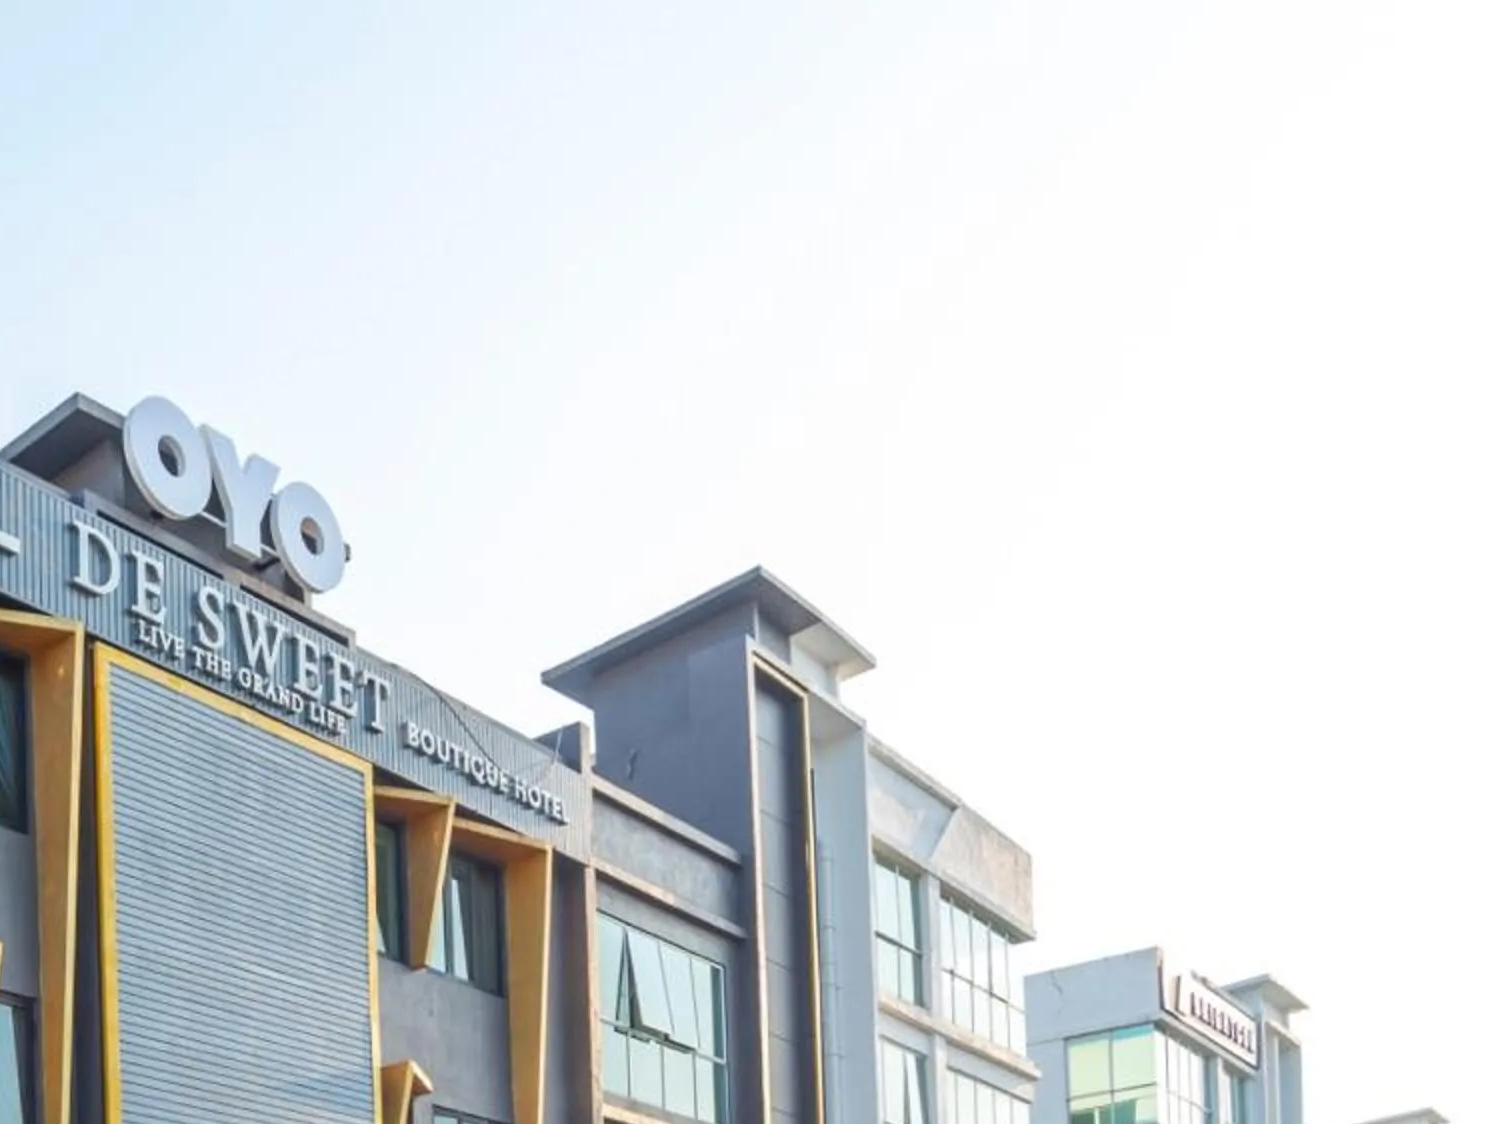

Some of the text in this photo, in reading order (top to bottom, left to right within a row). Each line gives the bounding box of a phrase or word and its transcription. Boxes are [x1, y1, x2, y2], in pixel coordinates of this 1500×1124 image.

[123, 396, 347, 595] OYO
[70, 519, 168, 624] DE
[197, 583, 392, 734] SWEET
[137, 619, 349, 737] LIVE THE GRAND LIFE
[406, 719, 571, 825] BOUTIQUE HOTEL
